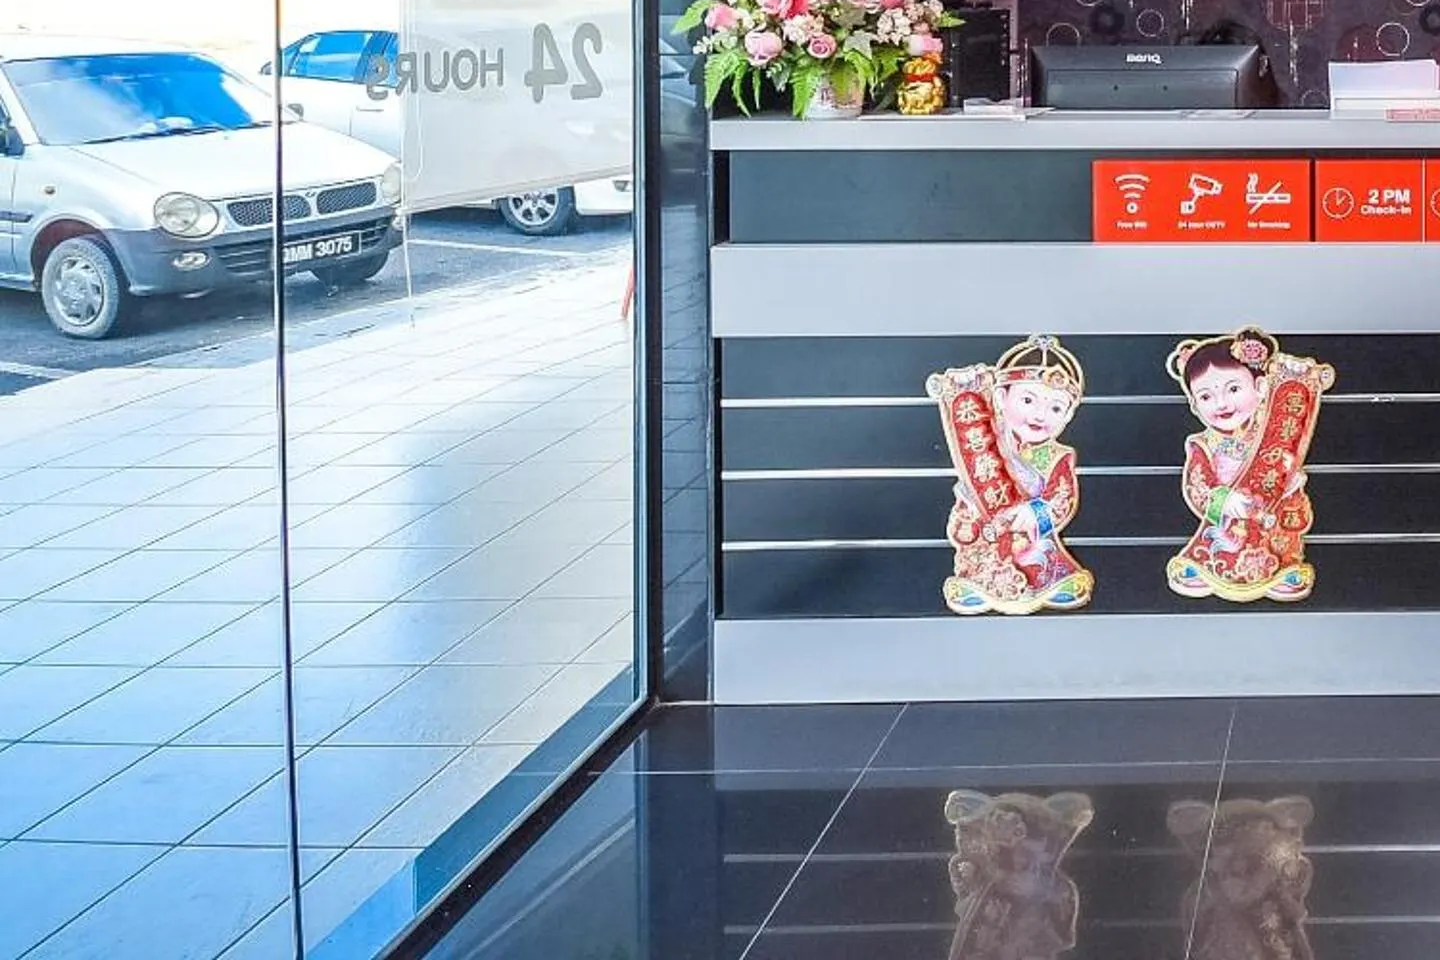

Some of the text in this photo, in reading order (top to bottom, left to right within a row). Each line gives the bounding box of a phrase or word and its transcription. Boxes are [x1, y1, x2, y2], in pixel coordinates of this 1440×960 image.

[1368, 189, 1411, 204] 2 PM
[1361, 204, 1412, 215] Check-in
[315, 236, 352, 257] 3075
